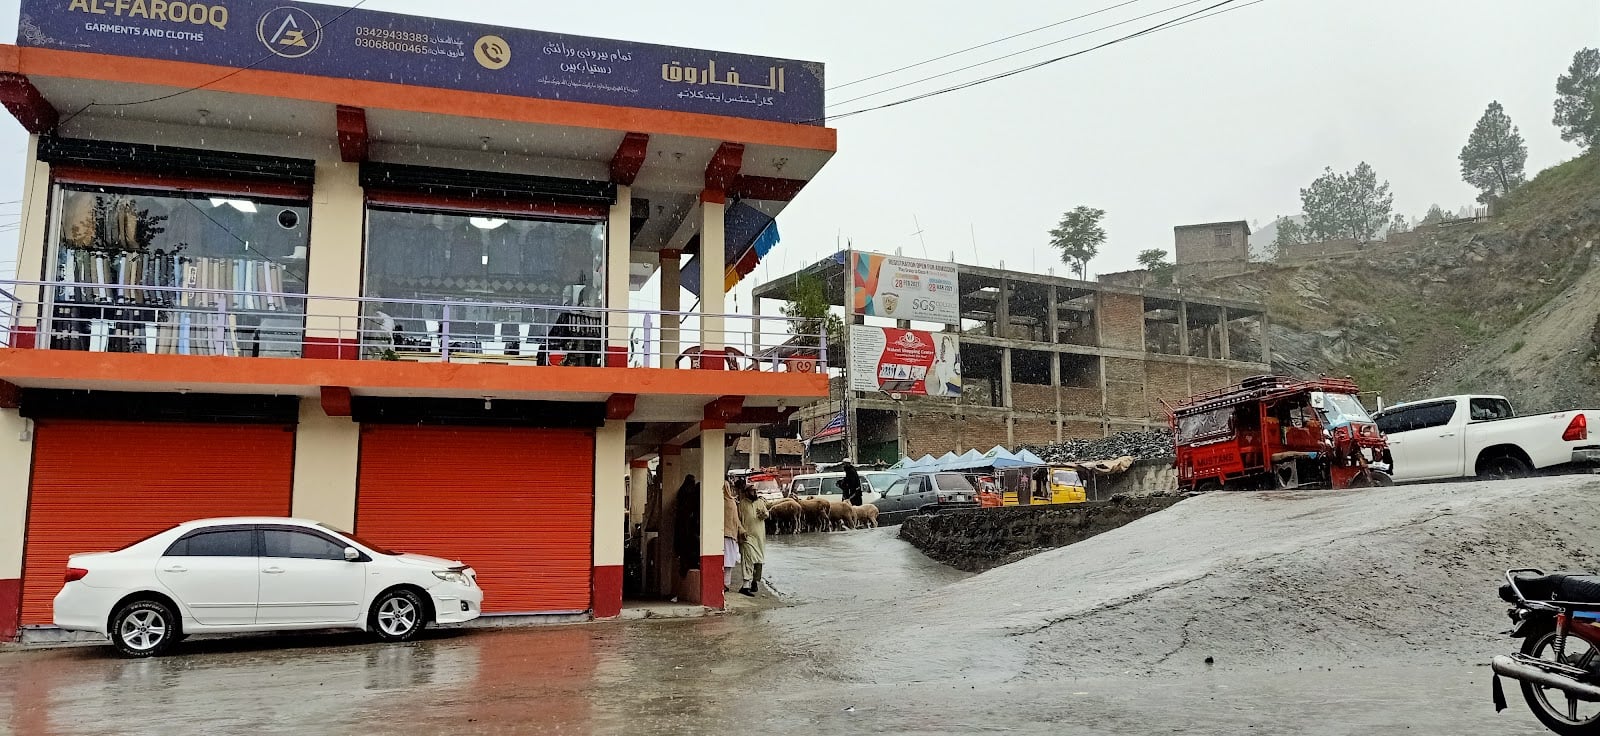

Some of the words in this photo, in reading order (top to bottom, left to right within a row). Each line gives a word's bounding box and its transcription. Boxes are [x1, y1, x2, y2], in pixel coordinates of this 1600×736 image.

[68, 0, 228, 30] AL-FAROOQ
[85, 22, 140, 36] GARMENTS
[143, 27, 164, 38] AND
[165, 30, 204, 42] CLOTHS
[355, 38, 428, 55] 03068000465
[610, 49, 632, 62] تمام
[662, 59, 785, 93] الفاروق
[916, 262, 927, 270] OPEN
[895, 279, 903, 288] 28
[912, 298, 935, 312] SGS
